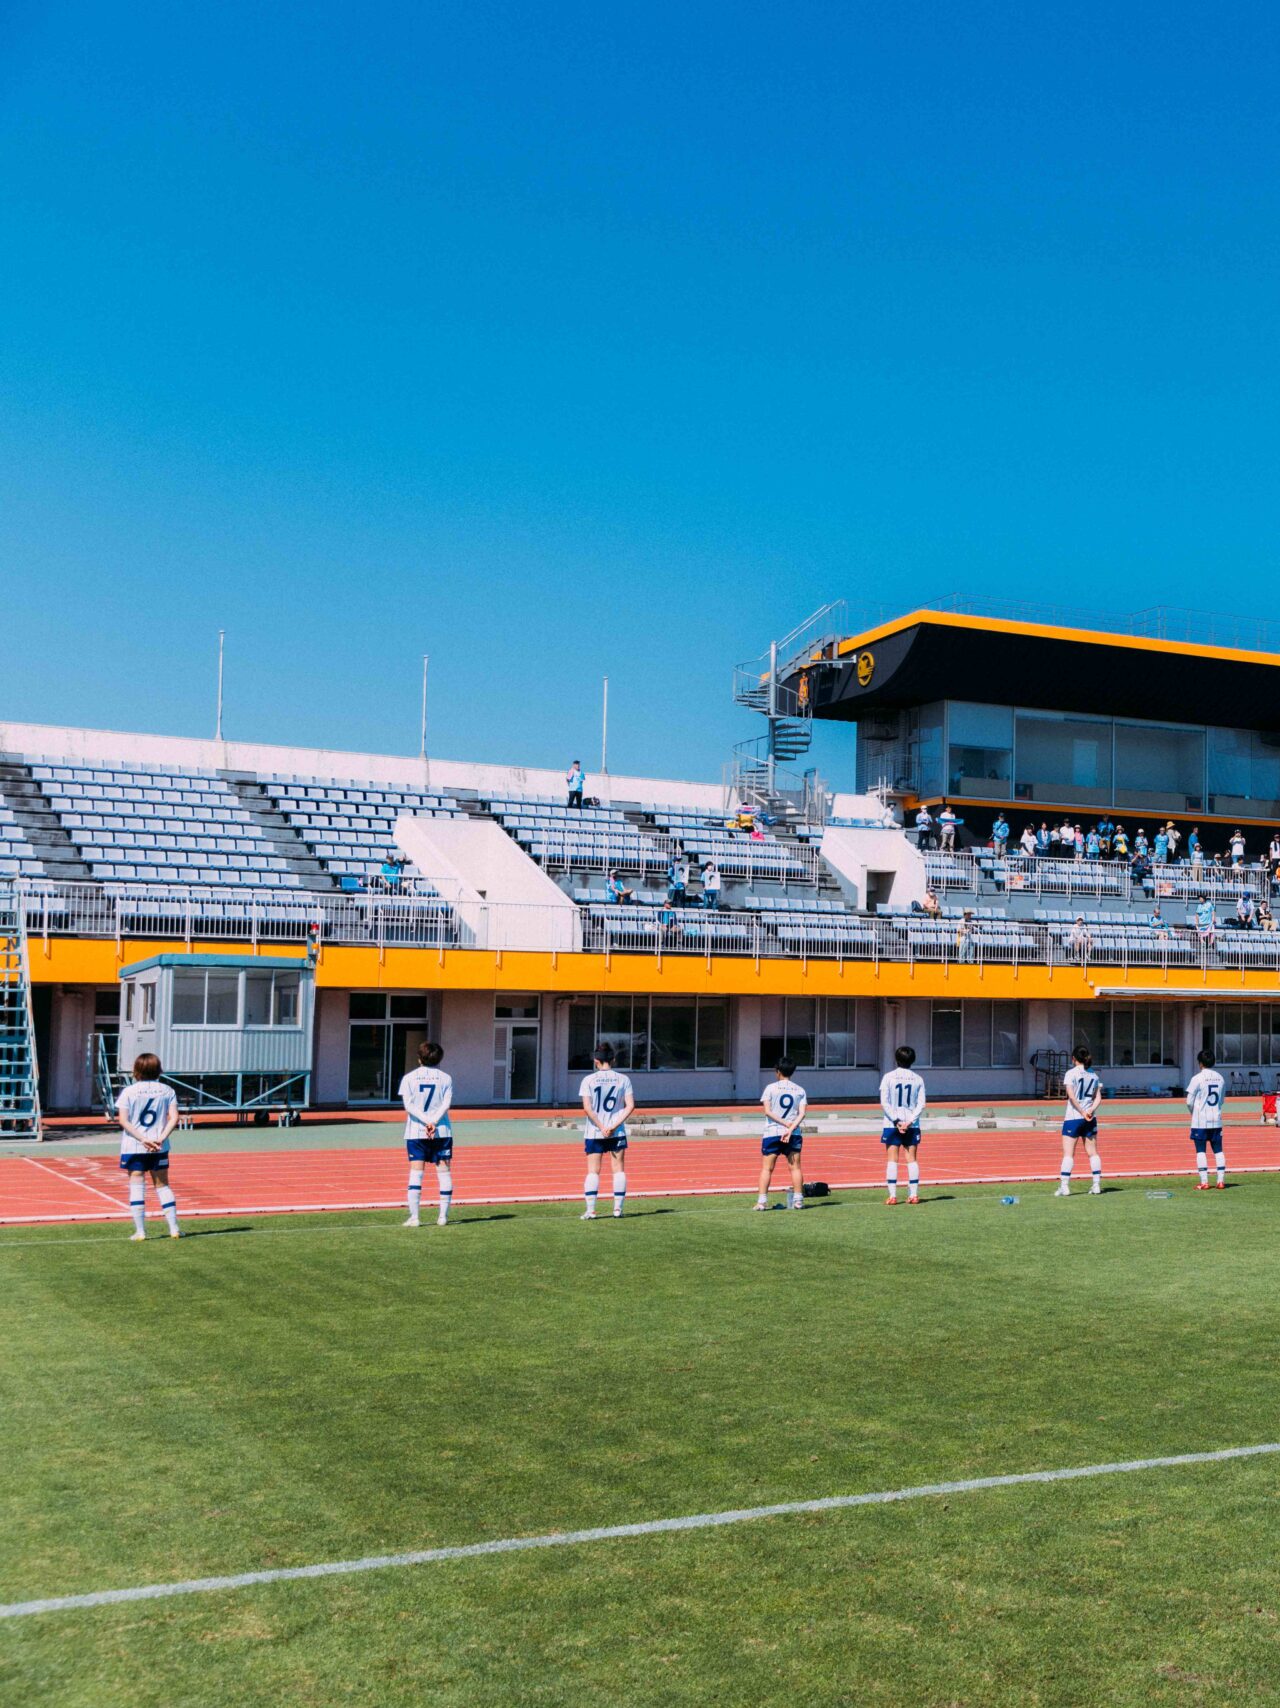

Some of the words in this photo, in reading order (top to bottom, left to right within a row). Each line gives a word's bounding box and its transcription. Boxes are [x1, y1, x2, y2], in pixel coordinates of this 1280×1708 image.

[419, 1084, 436, 1112] 7
[594, 1085, 617, 1113] 16
[895, 1083, 912, 1108] 11
[1078, 1077, 1096, 1100] 14
[1207, 1085, 1219, 1106] 5
[139, 1098, 157, 1127] 6
[779, 1094, 794, 1118] 9
